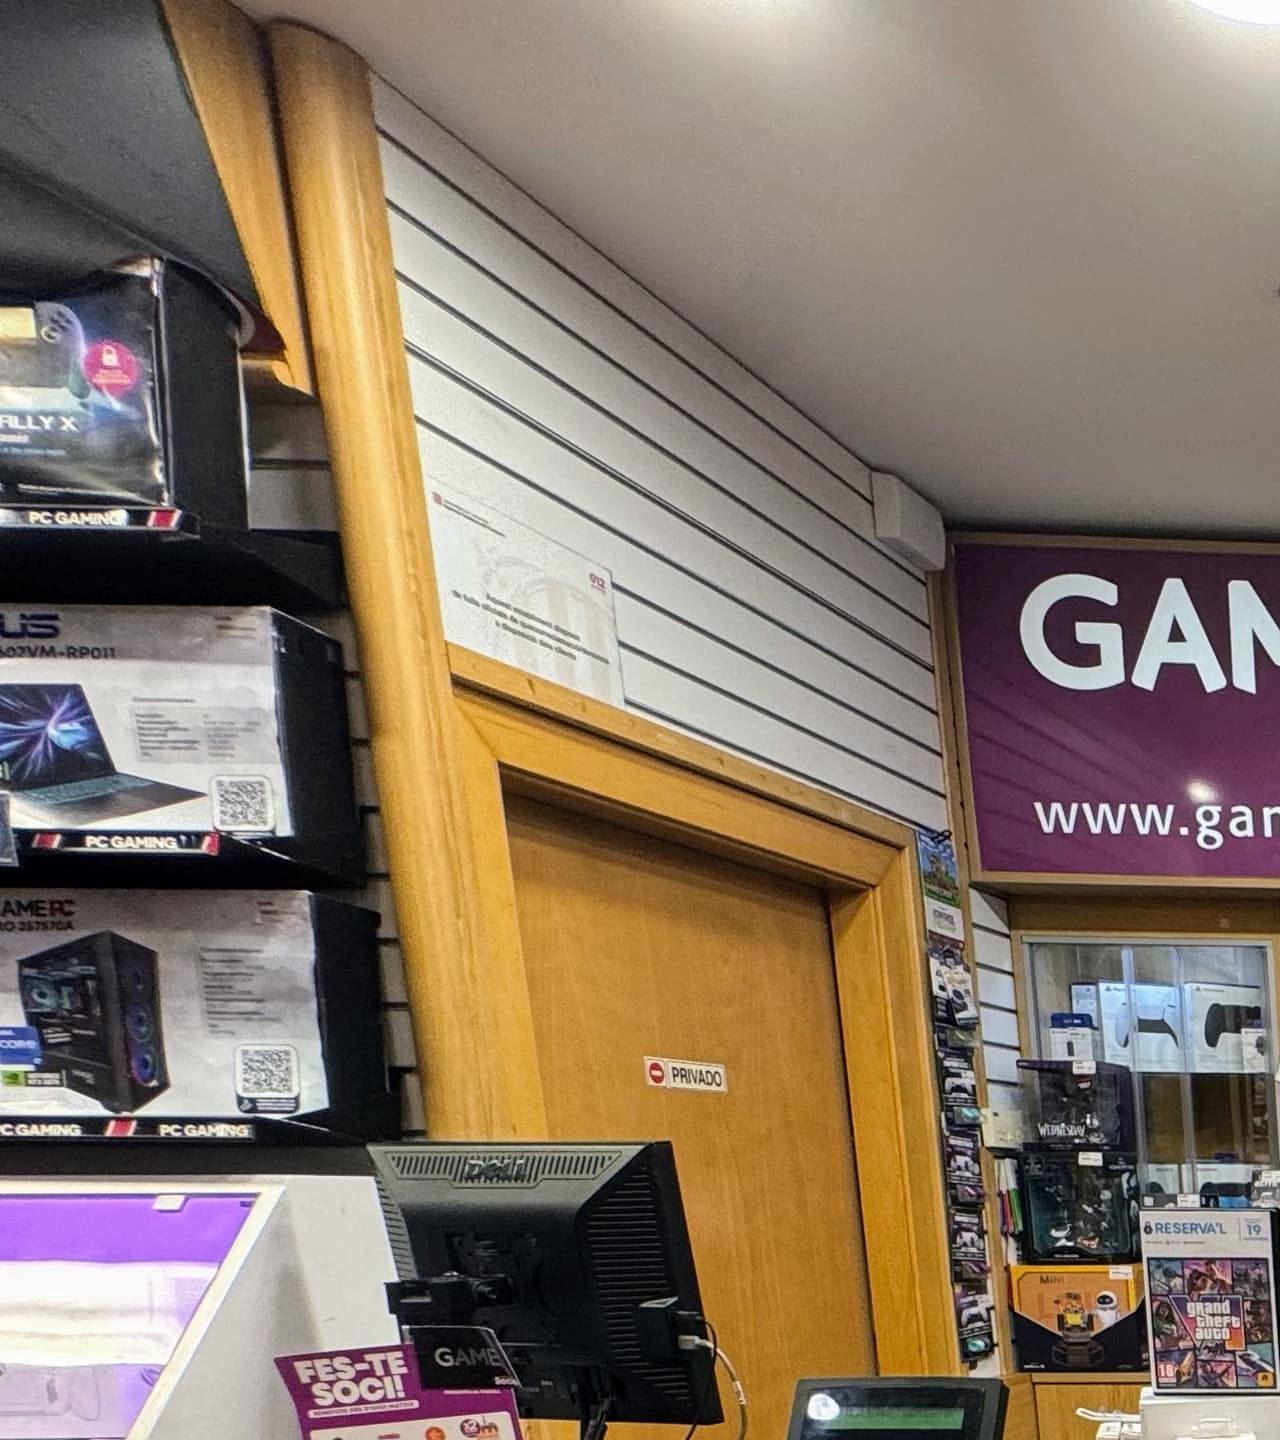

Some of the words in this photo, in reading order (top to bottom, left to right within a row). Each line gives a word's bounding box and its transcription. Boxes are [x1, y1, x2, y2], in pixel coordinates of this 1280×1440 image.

[28, 510, 52, 525] PC
[54, 510, 123, 526] GAMING
[86, 835, 108, 849] PC
[110, 835, 177, 850] GAMING
[671, 1066, 723, 1087] PRIVADO
[160, 1125, 183, 1137] PC
[185, 1125, 249, 1137] GAMING
[1155, 1222, 1228, 1235] RESERVA'L
[1247, 1225, 1262, 1236] 19
[1186, 1300, 1231, 1316] grand
[1196, 1315, 1240, 1328] theft
[1195, 1327, 1230, 1340] auto
[434, 1346, 503, 1367] GAME
[294, 1350, 409, 1385] FES-TE
[311, 1375, 405, 1407] SOCI!
